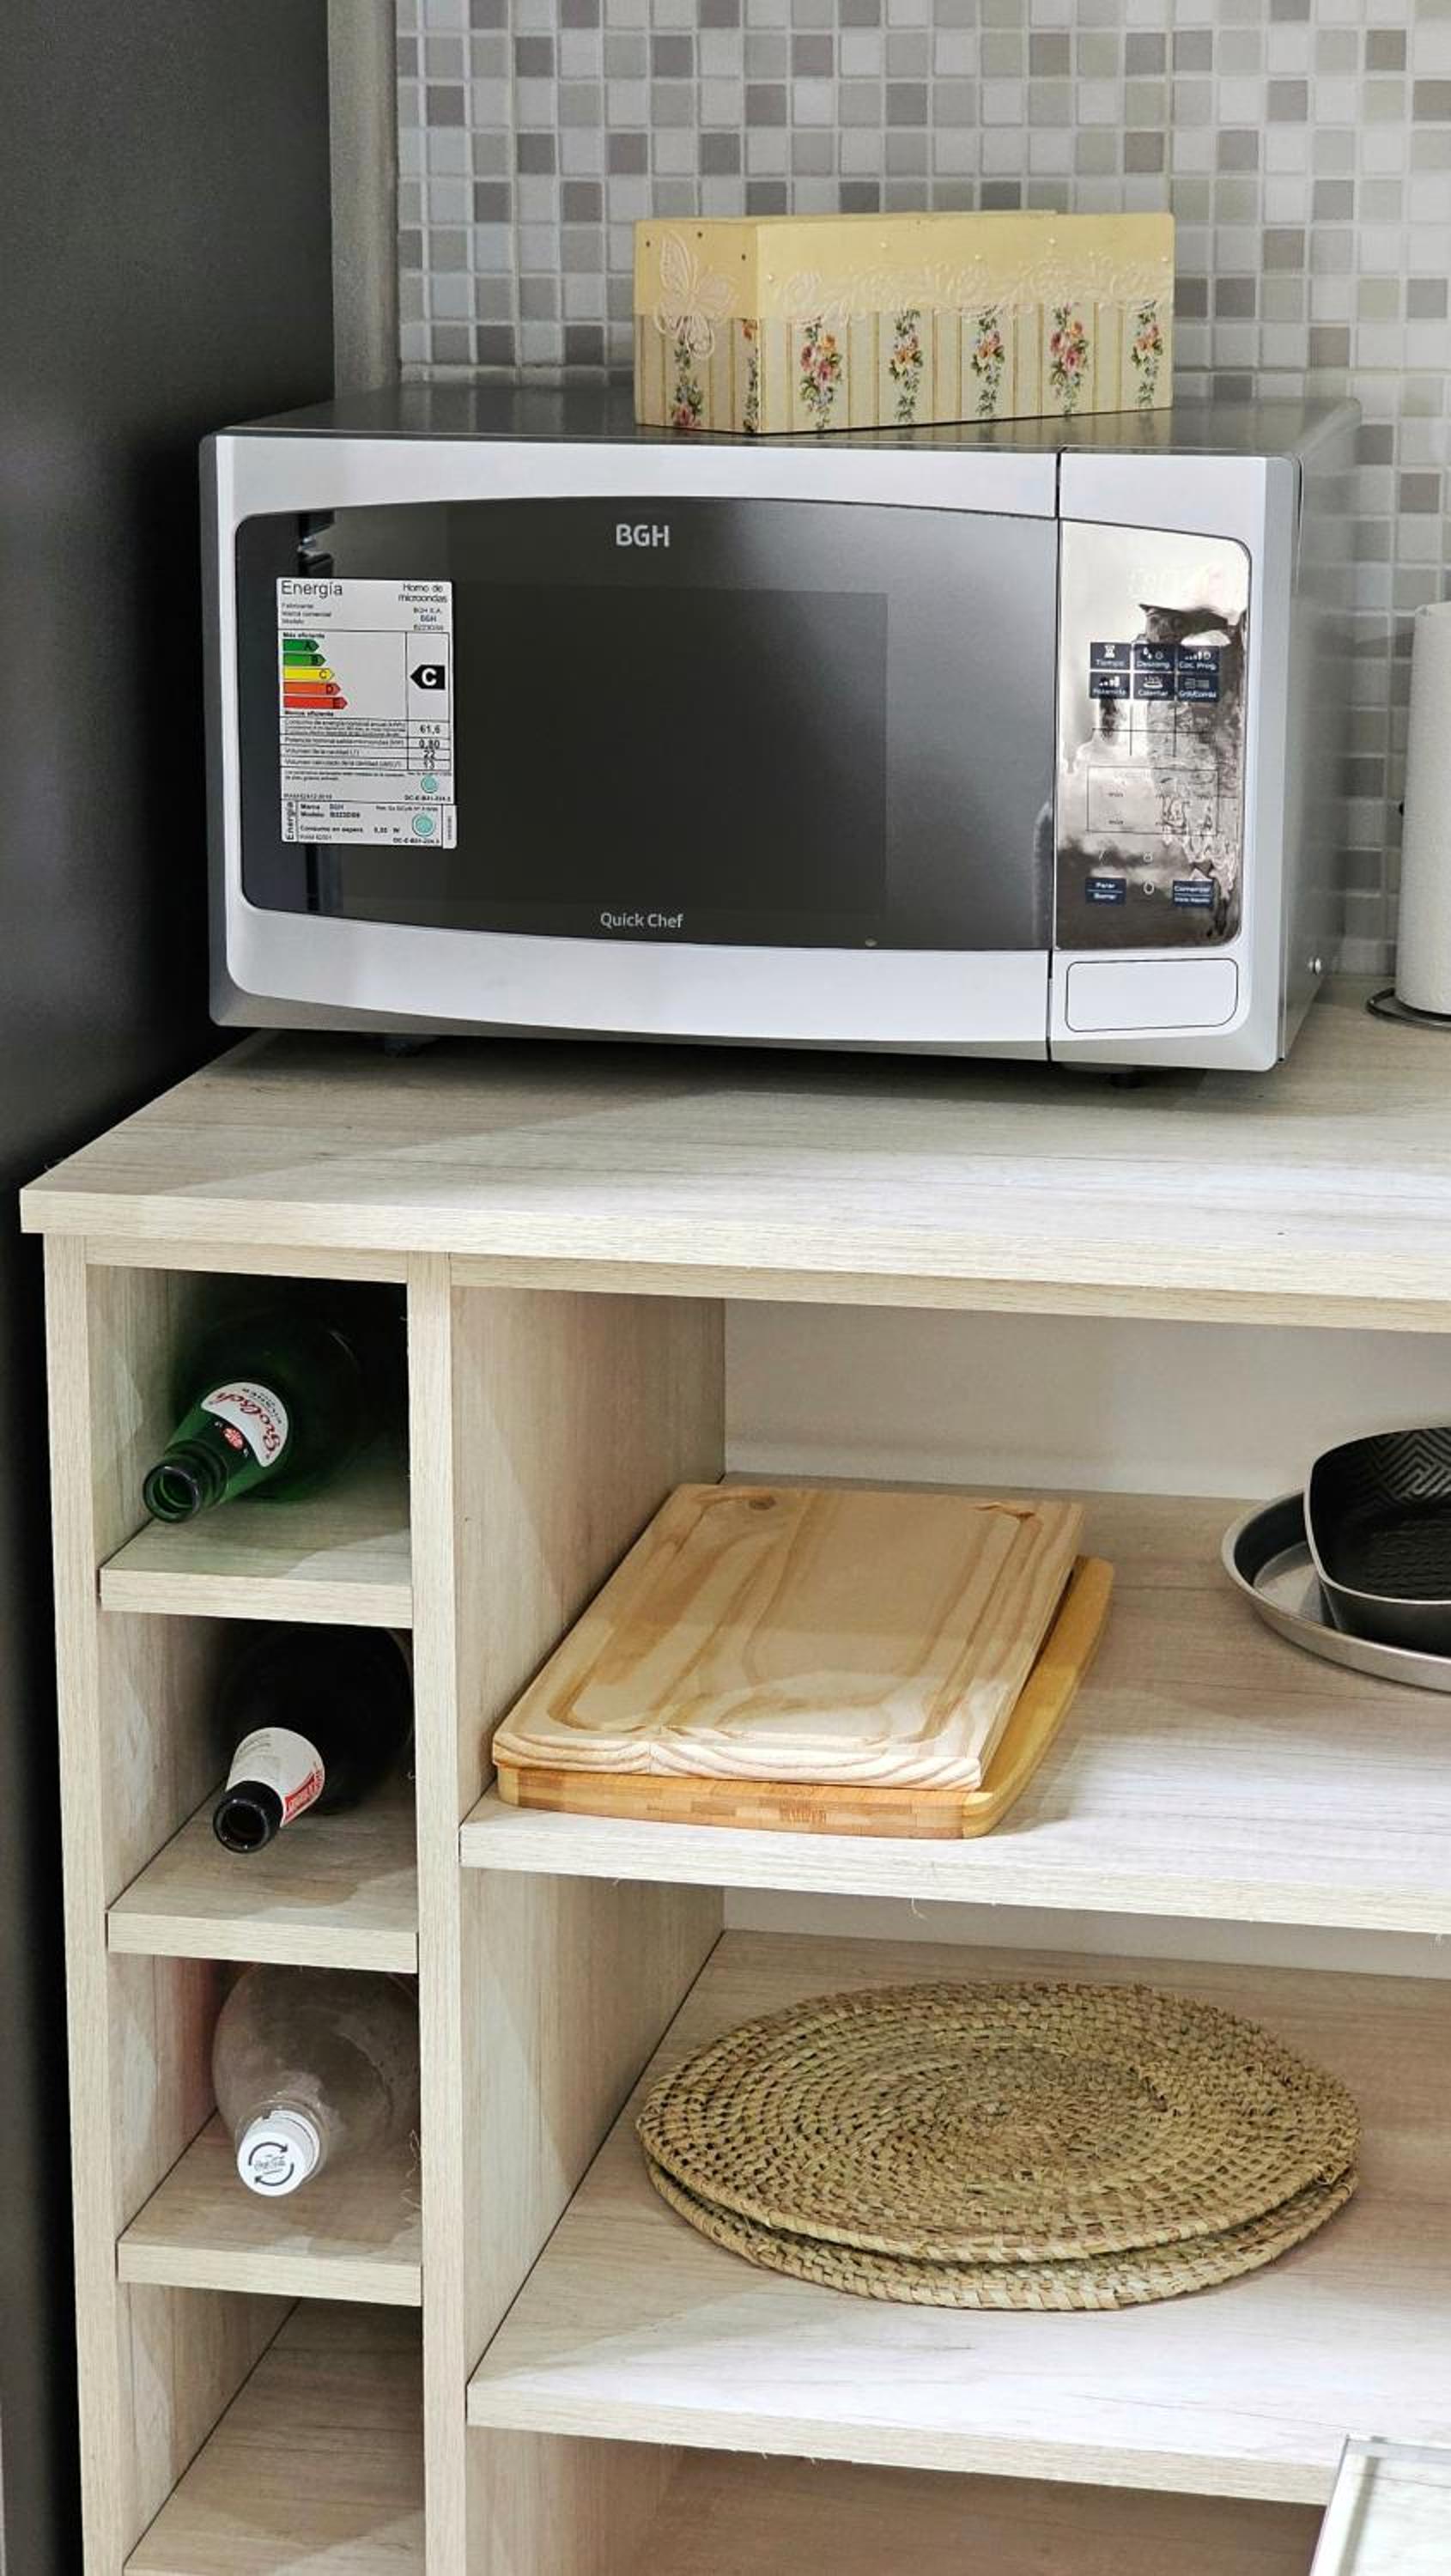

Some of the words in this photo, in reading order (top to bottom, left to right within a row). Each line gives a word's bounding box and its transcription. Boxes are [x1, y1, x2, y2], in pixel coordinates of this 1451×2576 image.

[616, 523, 670, 548] BGH
[281, 580, 343, 599] Energía
[319, 669, 327, 679] C
[421, 667, 437, 686] C
[326, 684, 334, 694] D
[423, 750, 435, 760] 22
[1095, 881, 1115, 890] Parar
[600, 911, 646, 930] Quick
[647, 912, 684, 928] Chef
